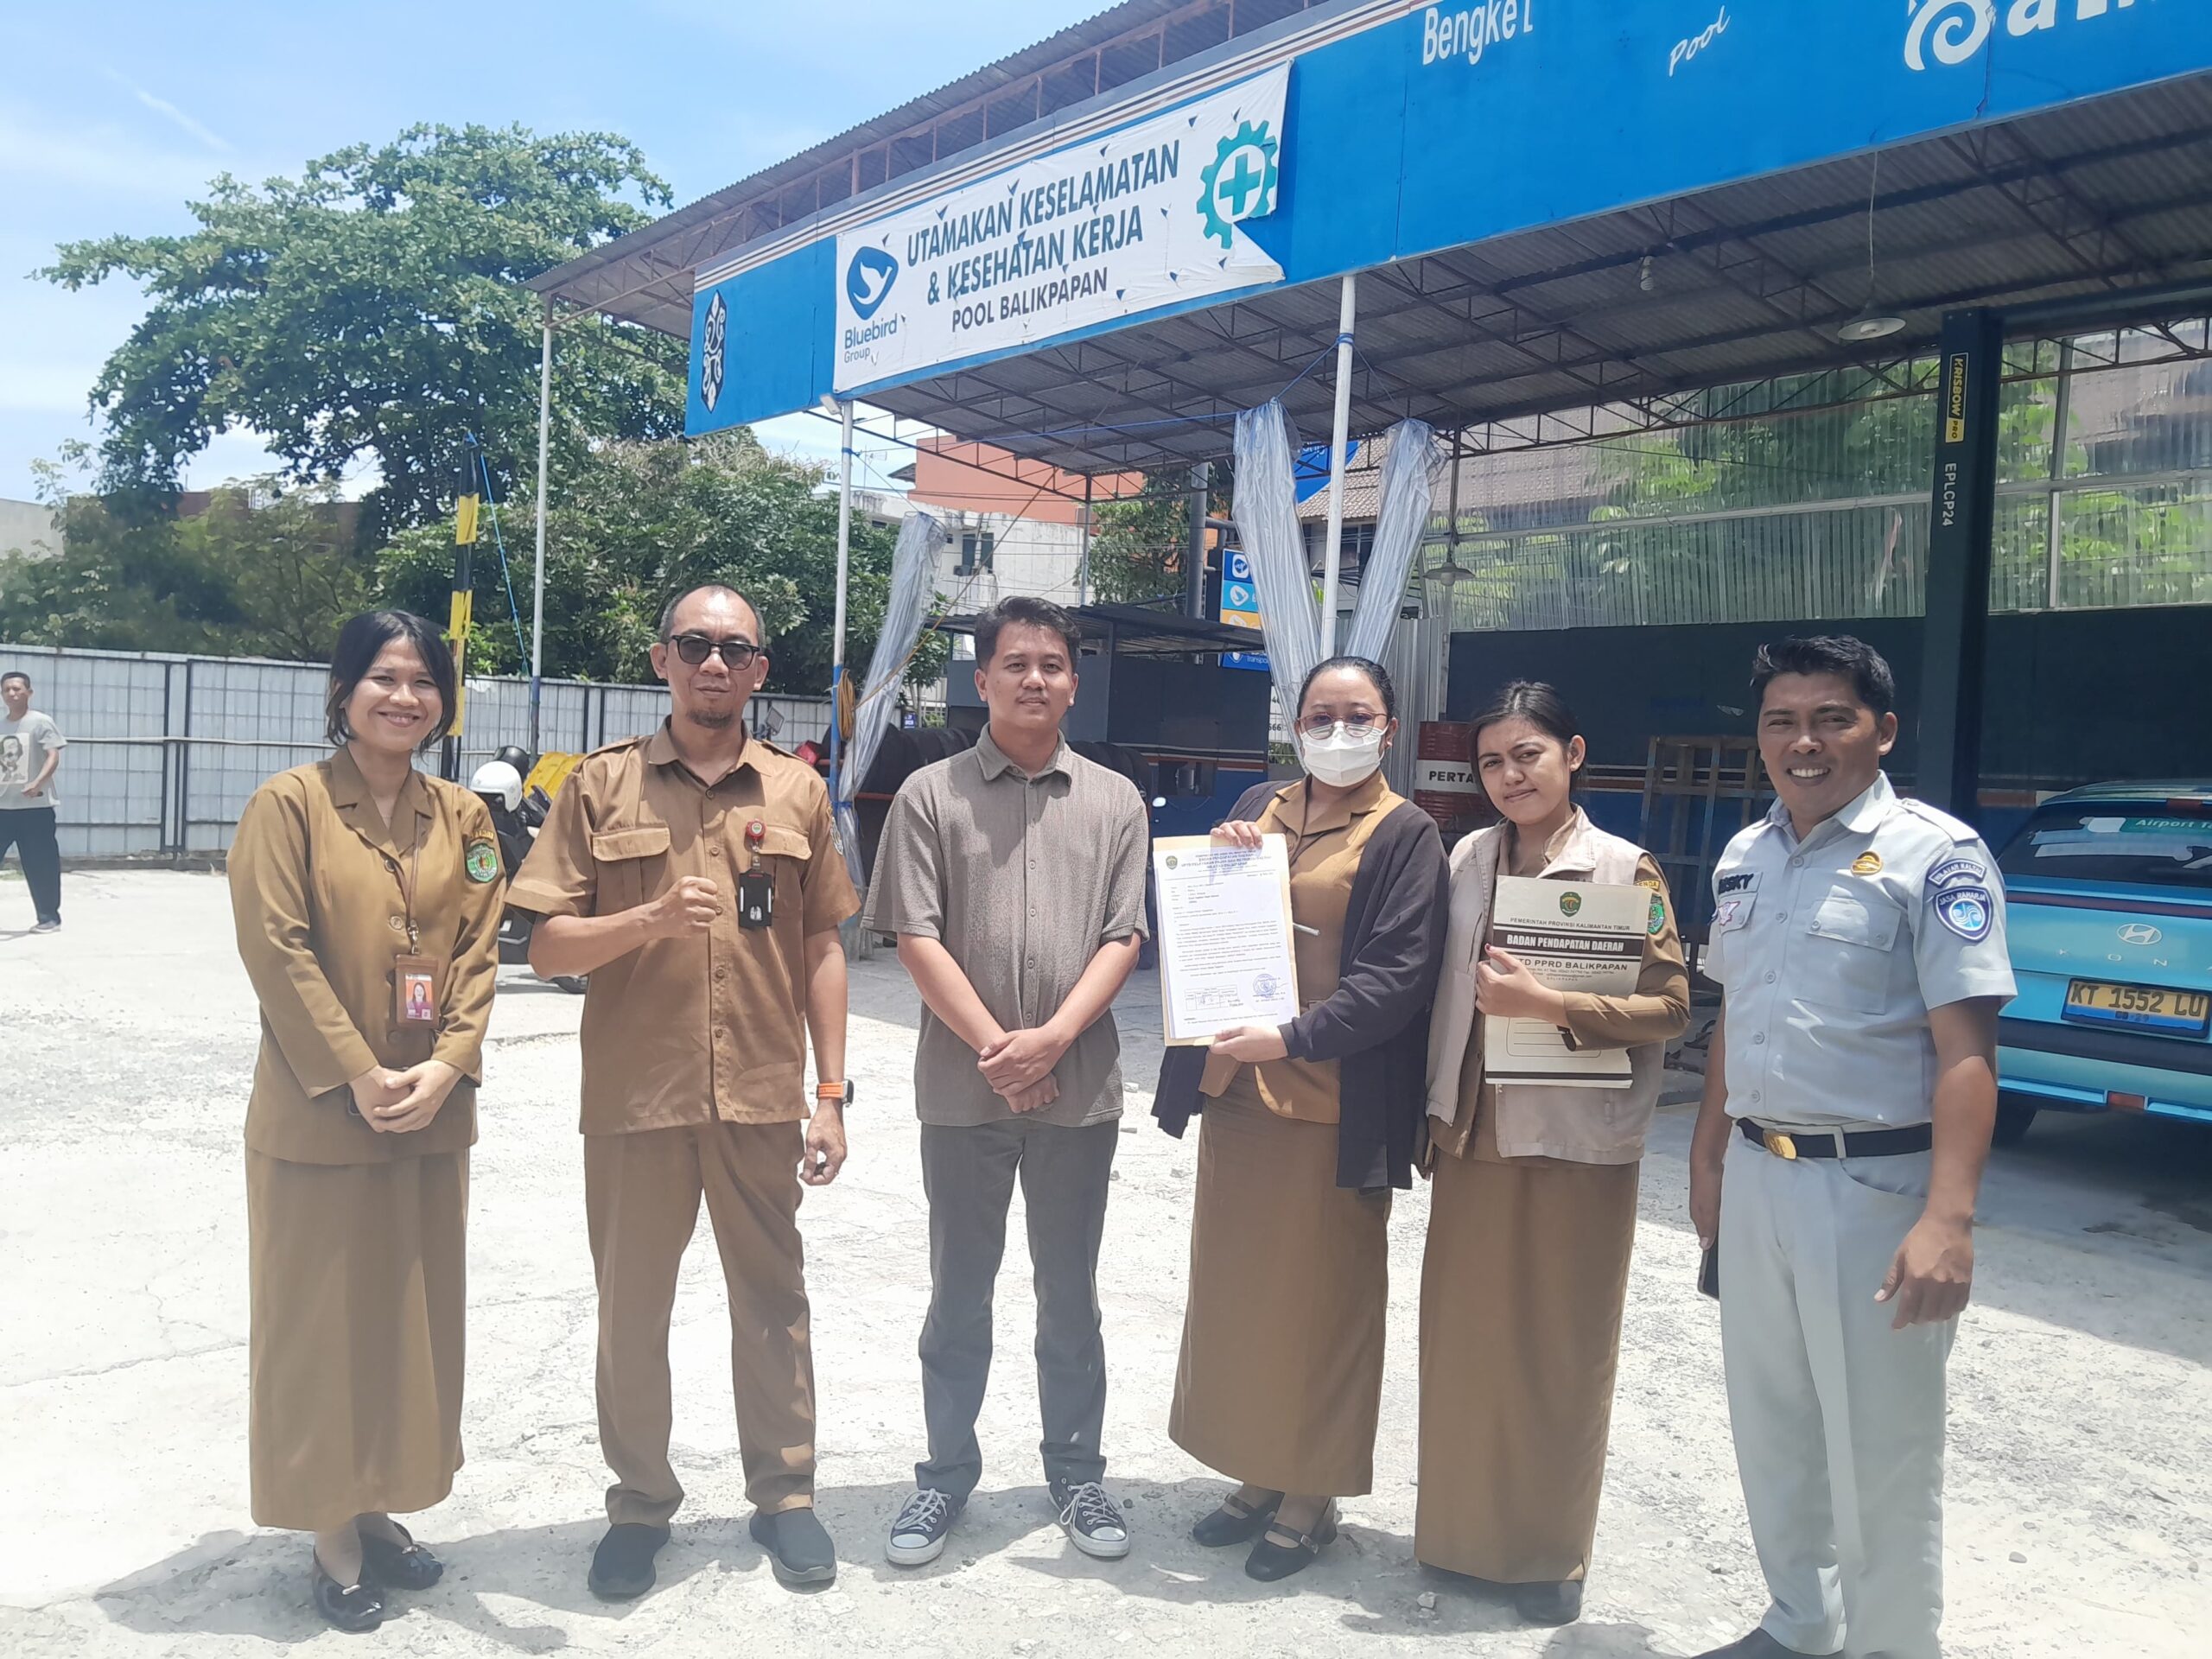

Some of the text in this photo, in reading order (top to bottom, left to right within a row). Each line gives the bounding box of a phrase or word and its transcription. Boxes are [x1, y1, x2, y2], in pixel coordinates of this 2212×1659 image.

[907, 139, 1179, 267] UTAMAKAN KESELAMATAN
[927, 205, 1143, 306] & KESEHATAN KERJA
[951, 266, 1108, 333] POOL BALIKPAPAN
[844, 312, 898, 350] Bluebird
[844, 346, 871, 364] Group
[1952, 358, 1964, 416] KRISBOW
[1942, 462, 1957, 526] EPLCP24
[1247, 655, 1268, 664] Transpo
[1428, 771, 1474, 784] PERTA
[2135, 819, 2195, 829] Airport
[1939, 893, 1956, 906] JASA
[1510, 917, 1547, 925] PEMERINTAH
[1576, 922, 1612, 931] KALIMANTAN
[1506, 934, 1624, 952] BADAN PENDAPATAN DAERAH
[1534, 959, 1563, 969] PPRD
[1565, 962, 1628, 971] BALIKPAPAN
[2070, 982, 2100, 1005] KT
[2107, 987, 2164, 1014] 1552
